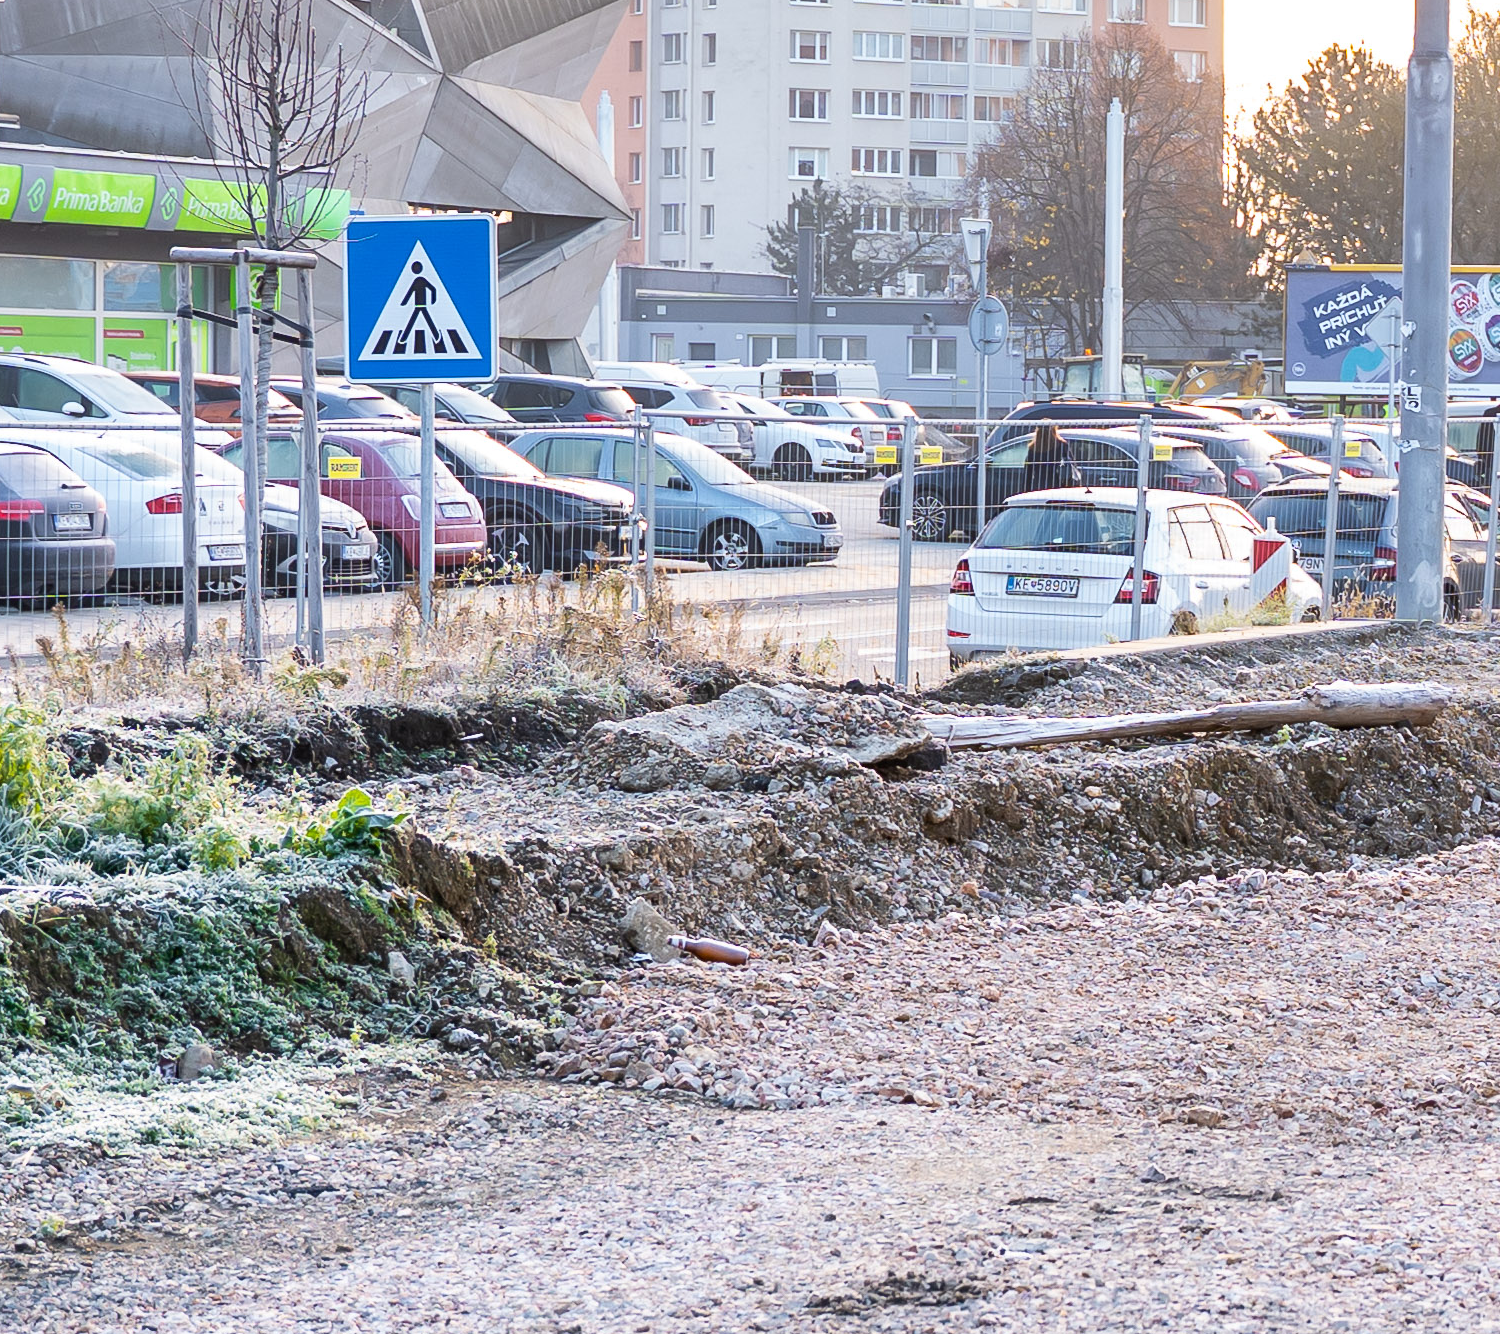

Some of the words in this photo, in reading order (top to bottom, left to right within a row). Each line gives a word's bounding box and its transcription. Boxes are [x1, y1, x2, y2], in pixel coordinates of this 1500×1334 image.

[54, 186, 99, 212] Prima
[99, 190, 144, 214] Banka
[186, 195, 228, 219] Prima
[1313, 283, 1374, 319] KAŽDÁ
[1455, 291, 1477, 314] SYX
[1318, 294, 1388, 334] PRÍCHUŤ
[1324, 328, 1351, 350] INÝ
[1454, 338, 1476, 361] SYX
